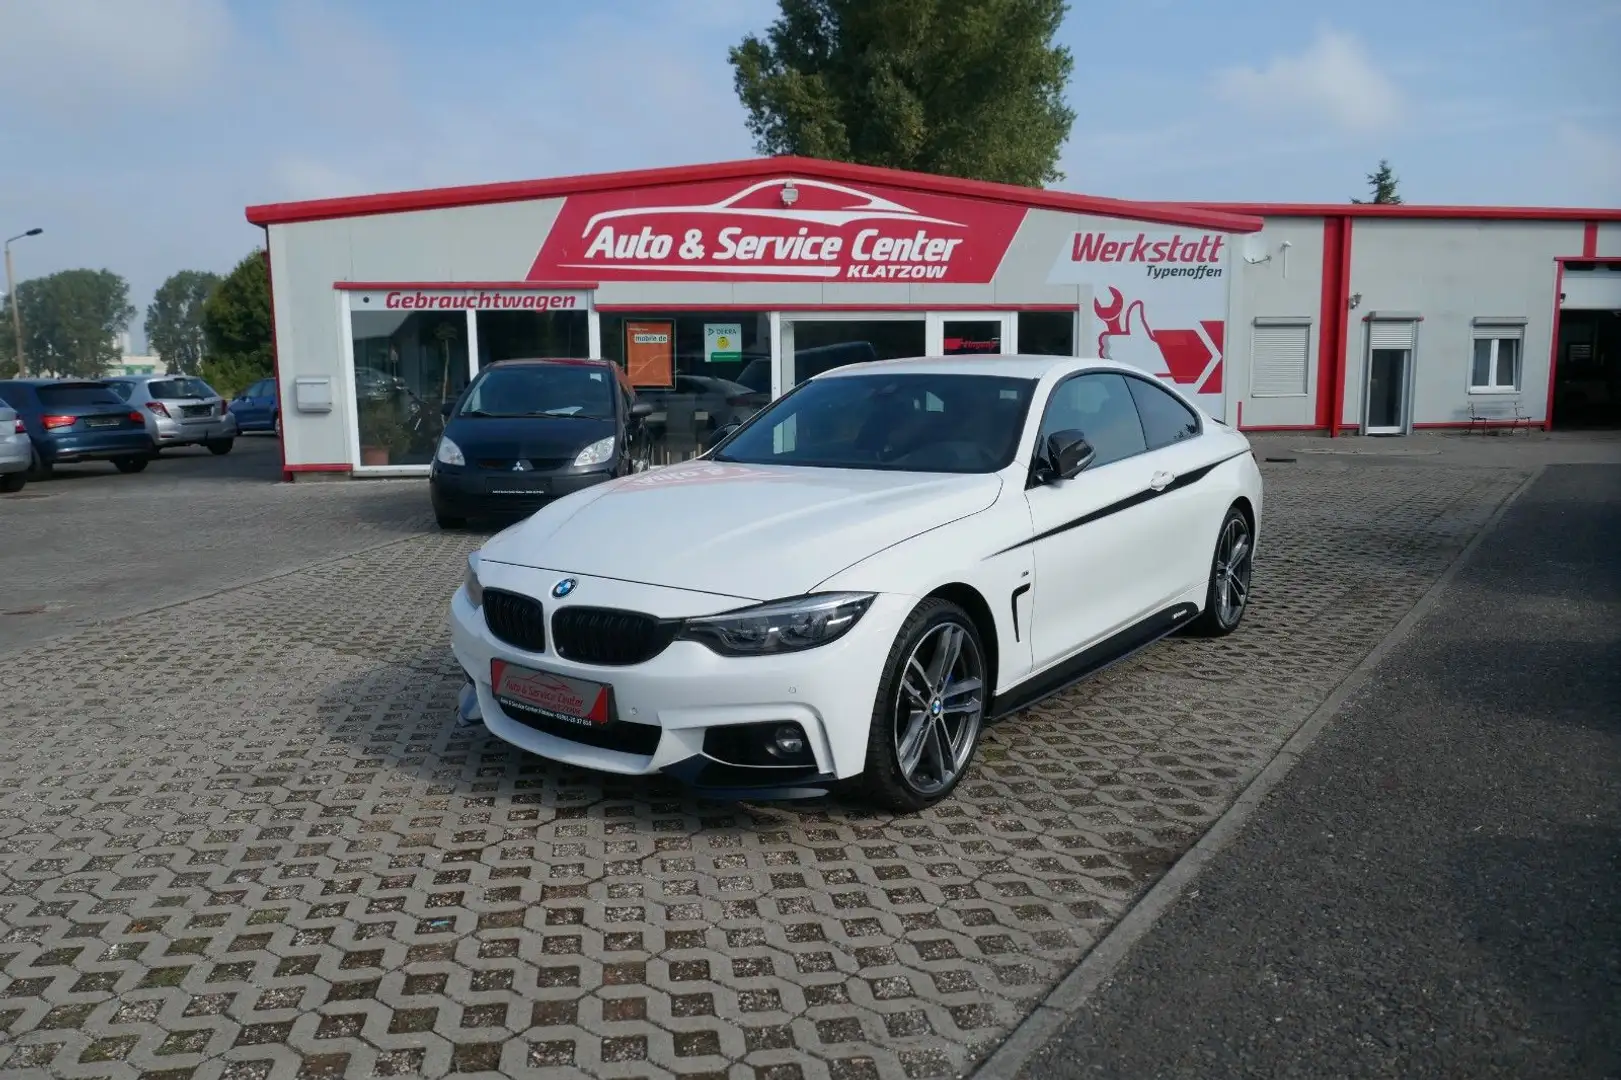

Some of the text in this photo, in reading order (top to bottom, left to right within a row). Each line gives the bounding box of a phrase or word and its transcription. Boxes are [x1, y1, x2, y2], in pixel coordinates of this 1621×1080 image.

[584, 225, 964, 262] Auto & Service Center
[1071, 232, 1225, 263] Werkstatt
[846, 265, 948, 279] KLATZOW
[1146, 265, 1222, 280] Typenoffen
[386, 291, 576, 313] Gebrauchtwagen
